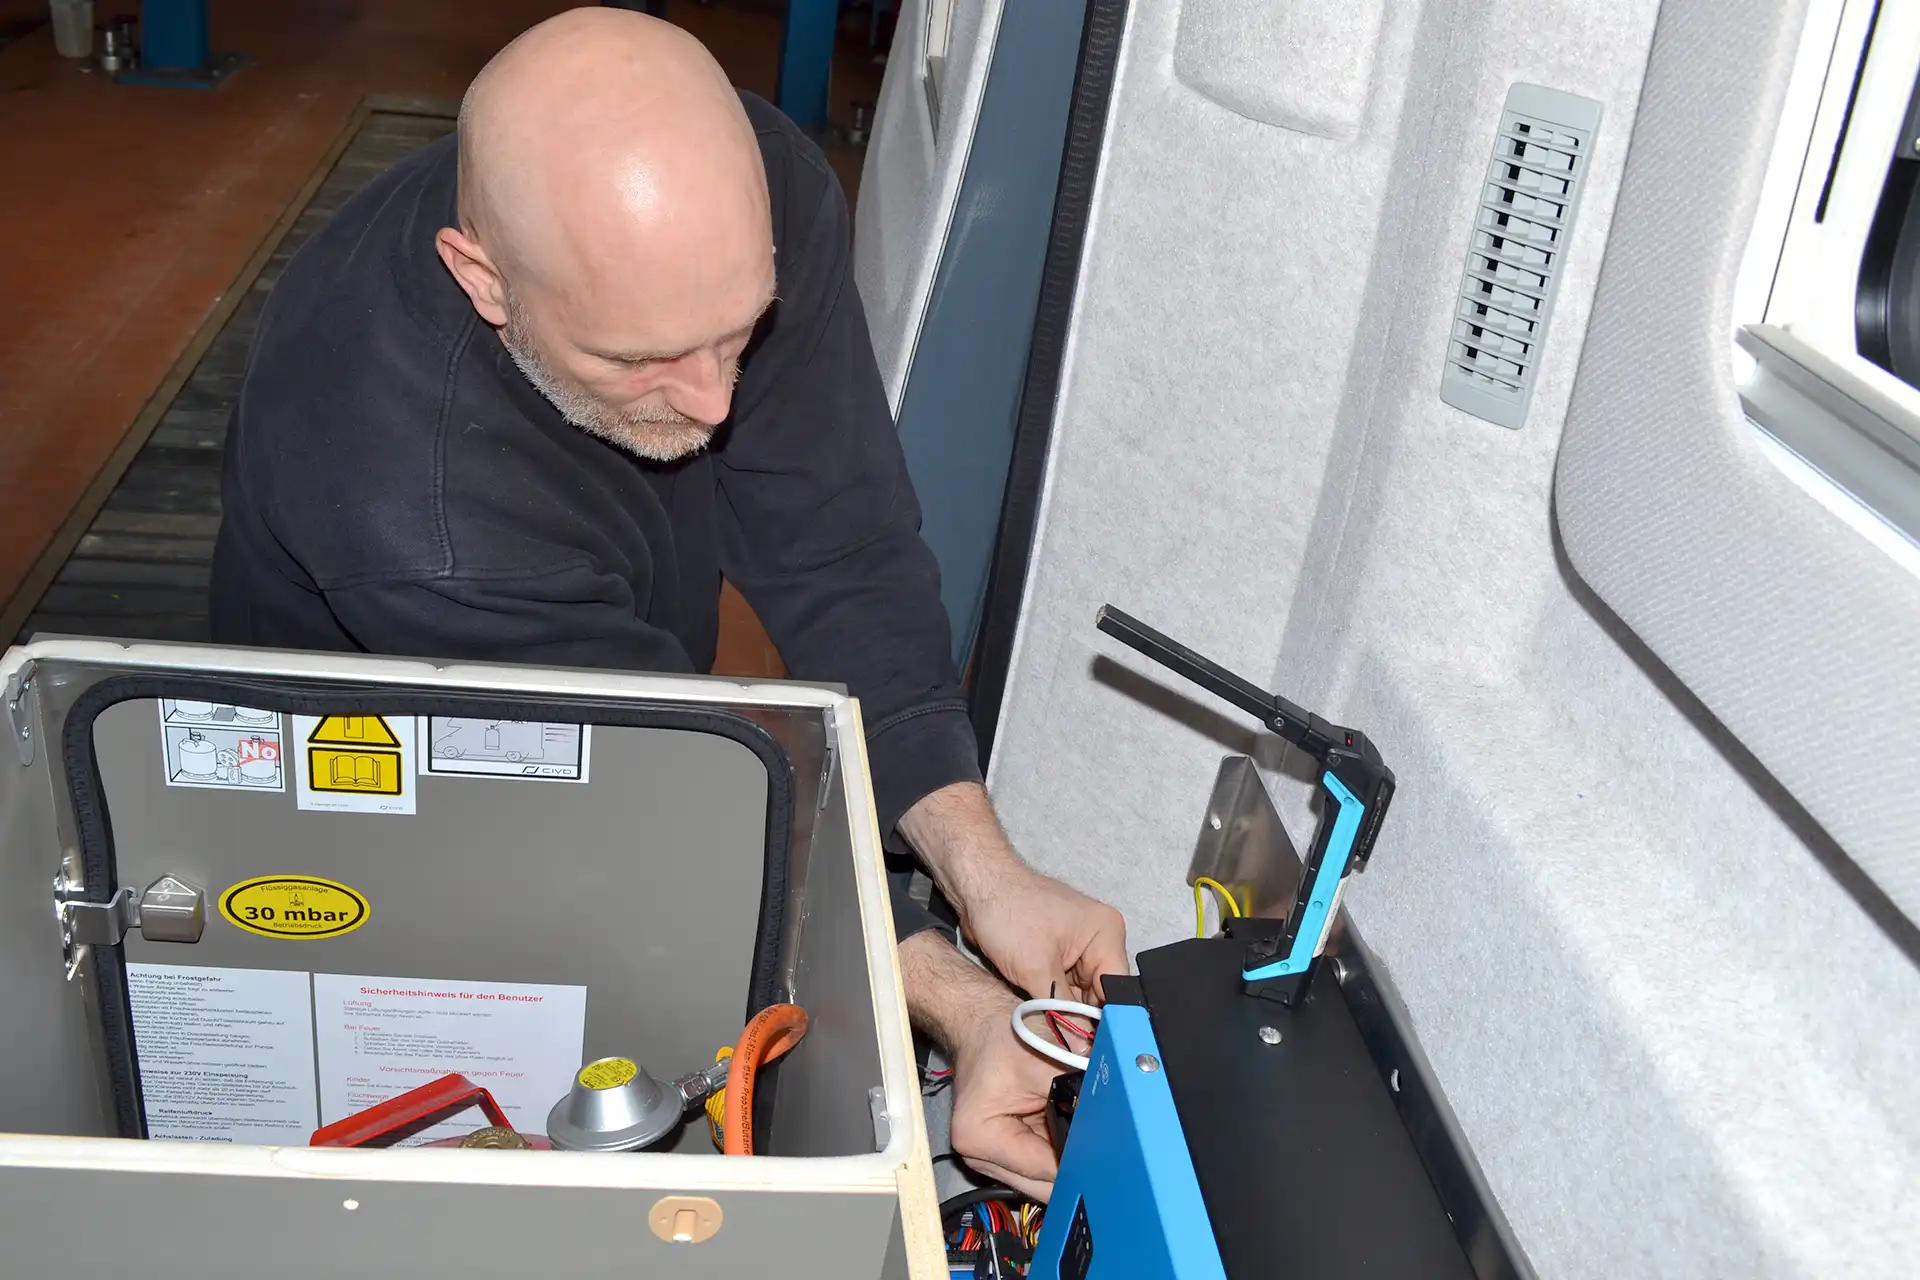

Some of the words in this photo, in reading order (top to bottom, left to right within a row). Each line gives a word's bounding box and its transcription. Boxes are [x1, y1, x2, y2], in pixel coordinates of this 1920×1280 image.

[241, 741, 277, 760] No
[261, 884, 329, 894] Flüssiggasanlage
[244, 906, 275, 920] 30
[284, 907, 349, 922] mbar
[130, 972, 162, 980] Achtung
[360, 987, 456, 999] Sicherheitshinweis
[498, 994, 544, 1002] Benutzer
[343, 999, 372, 1008] Lüftung
[203, 1071, 249, 1079] Einspeisung
[158, 1108, 213, 1116] Reifenluftdruck
